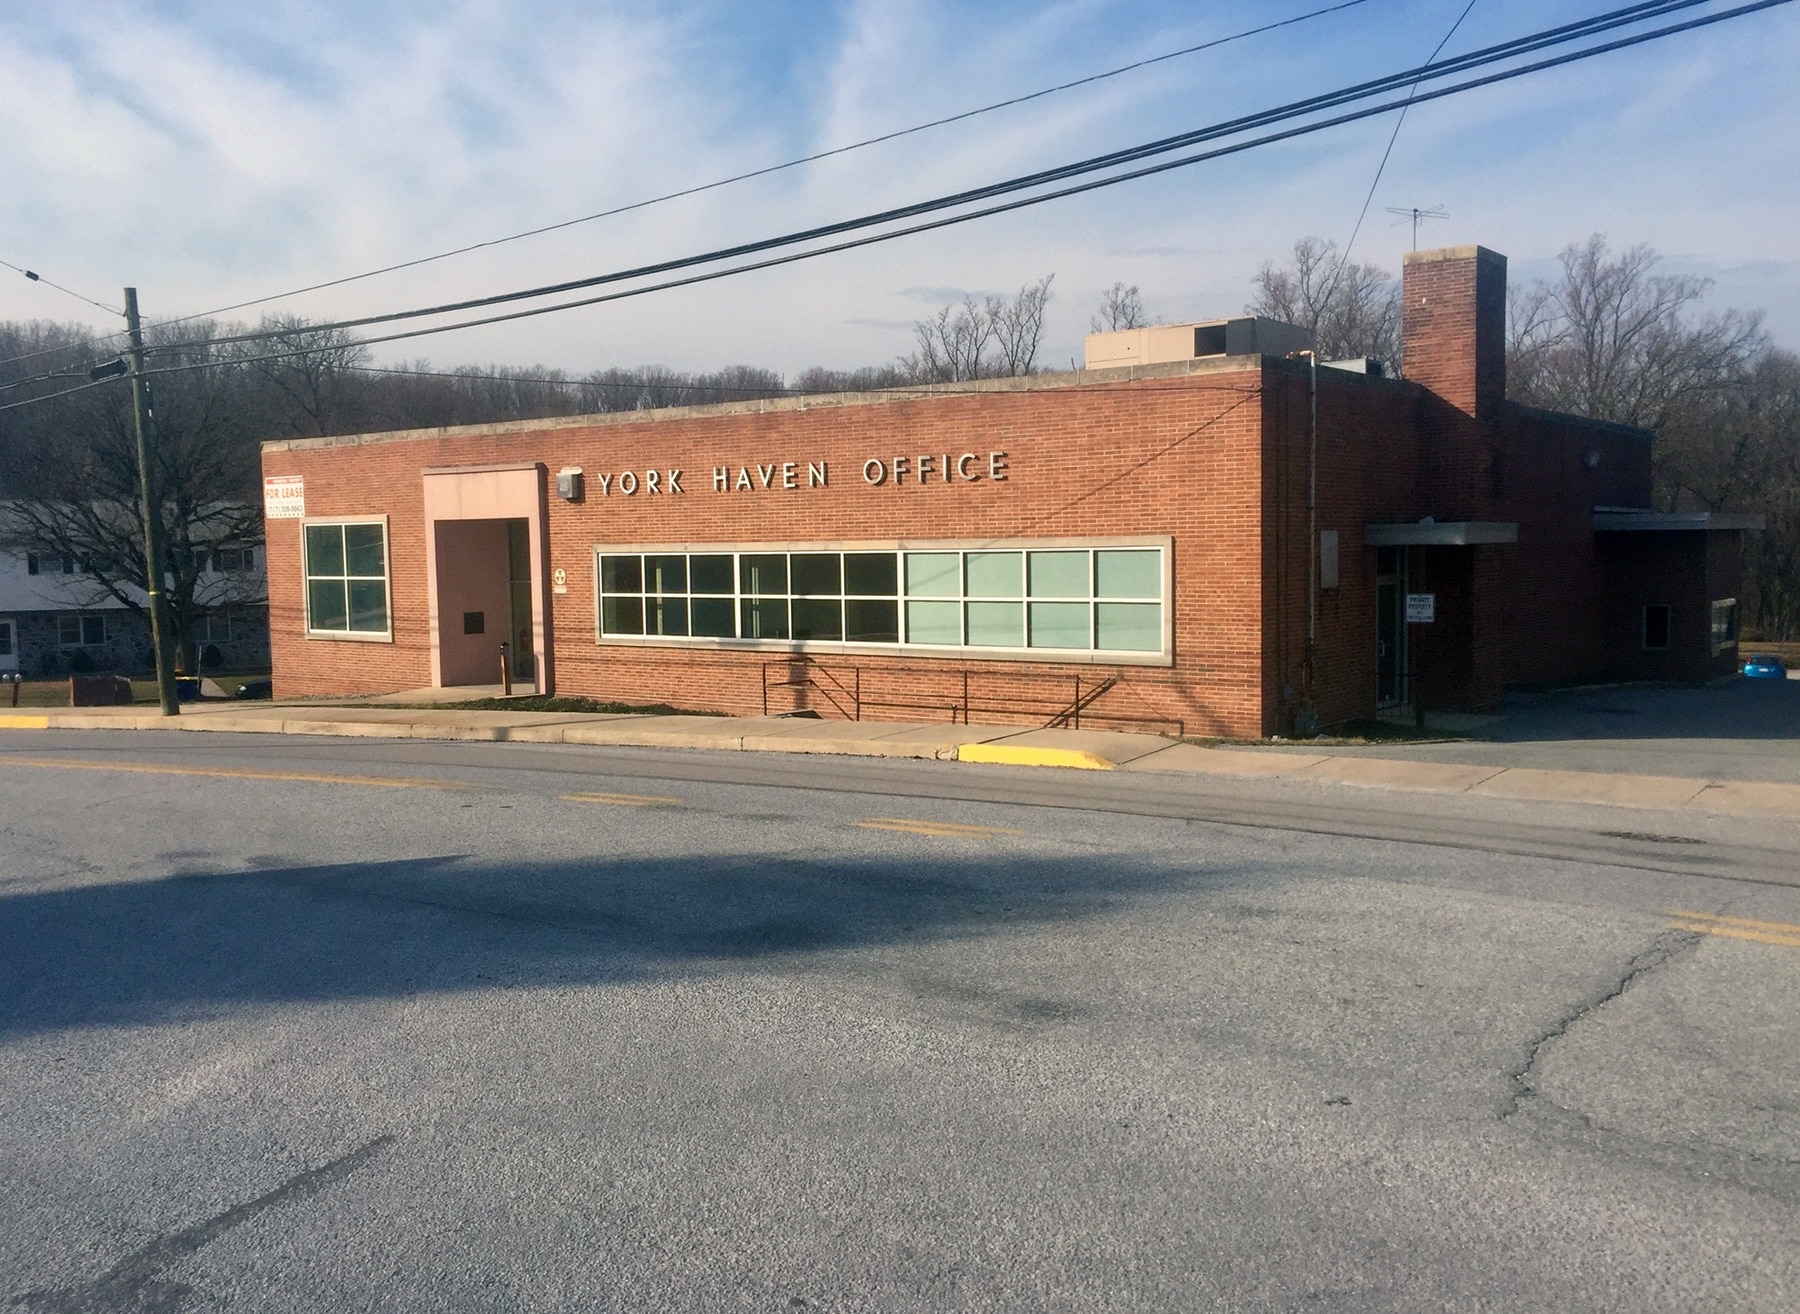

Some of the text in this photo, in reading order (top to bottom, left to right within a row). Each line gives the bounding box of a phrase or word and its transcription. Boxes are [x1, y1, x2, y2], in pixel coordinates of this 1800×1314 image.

[598, 451, 1006, 495] YORK HAVEN OFFICE
[266, 487, 303, 499] FOR LEASE
